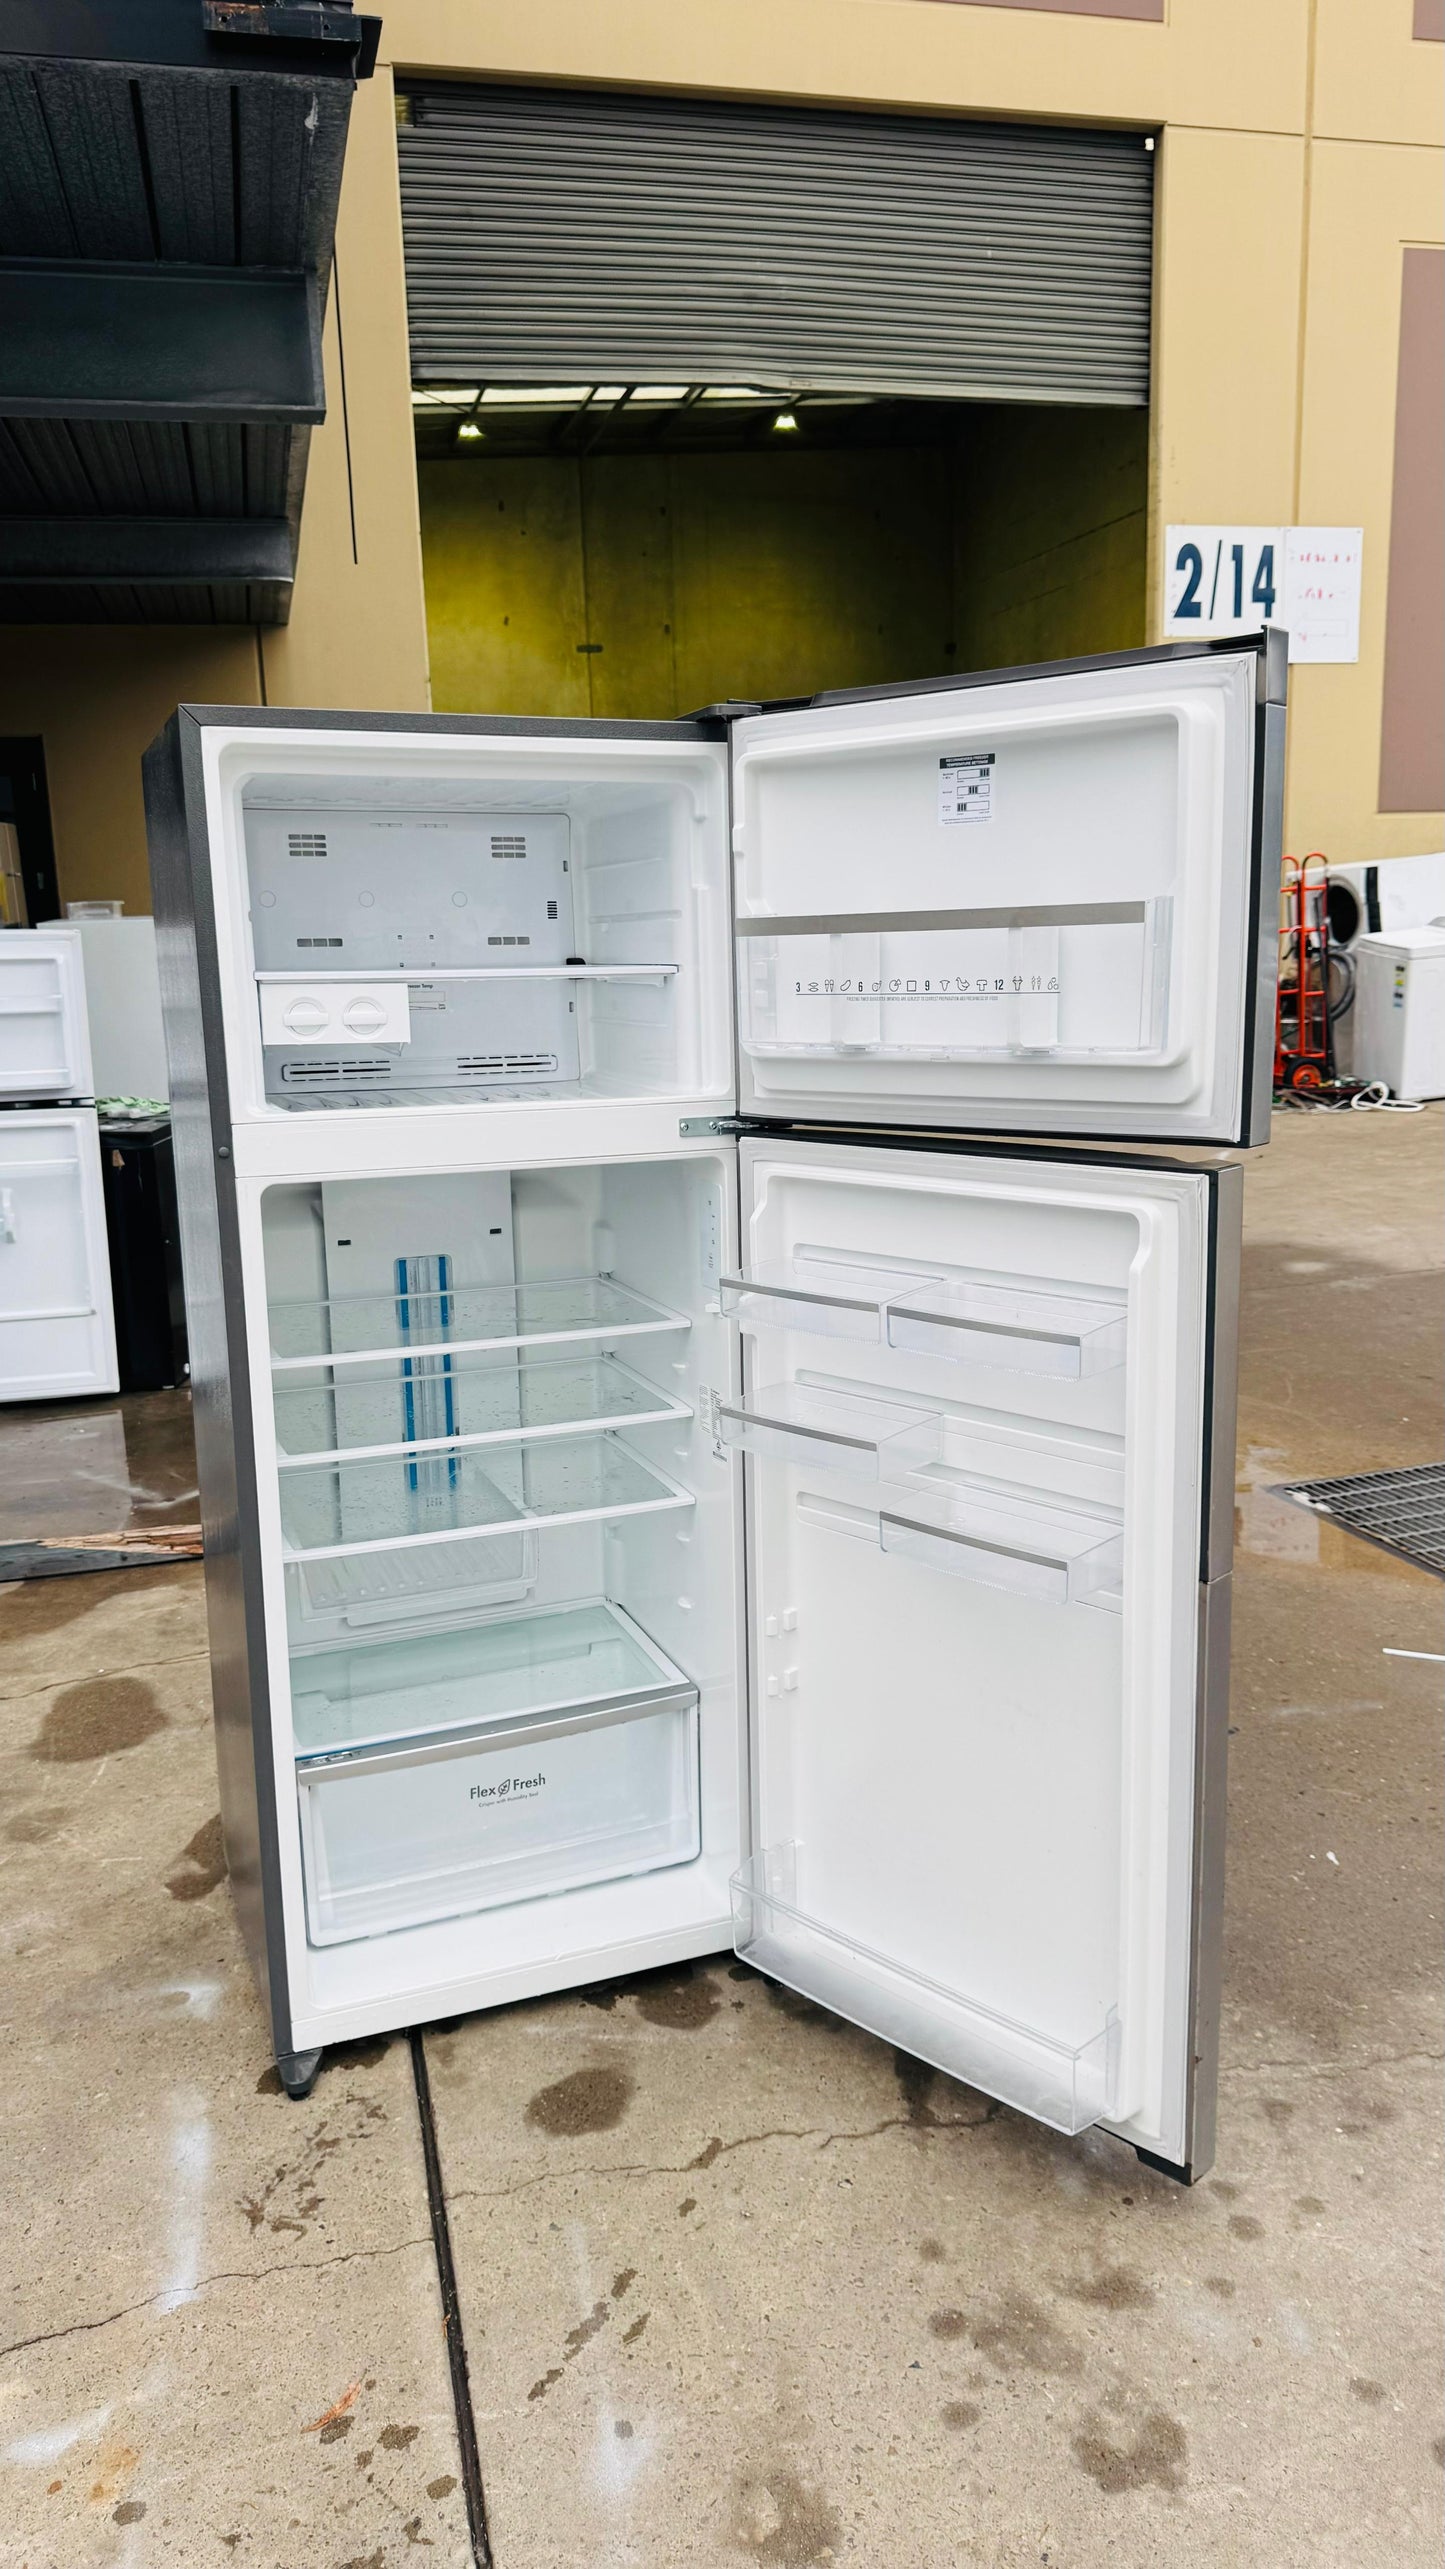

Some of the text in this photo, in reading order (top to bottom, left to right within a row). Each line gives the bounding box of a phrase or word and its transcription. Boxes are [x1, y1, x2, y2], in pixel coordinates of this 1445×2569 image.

[1173, 539, 1276, 621] 2/14
[795, 979, 1004, 993] 3 6 9 12
[470, 1773, 546, 1800] Flex Fresh
